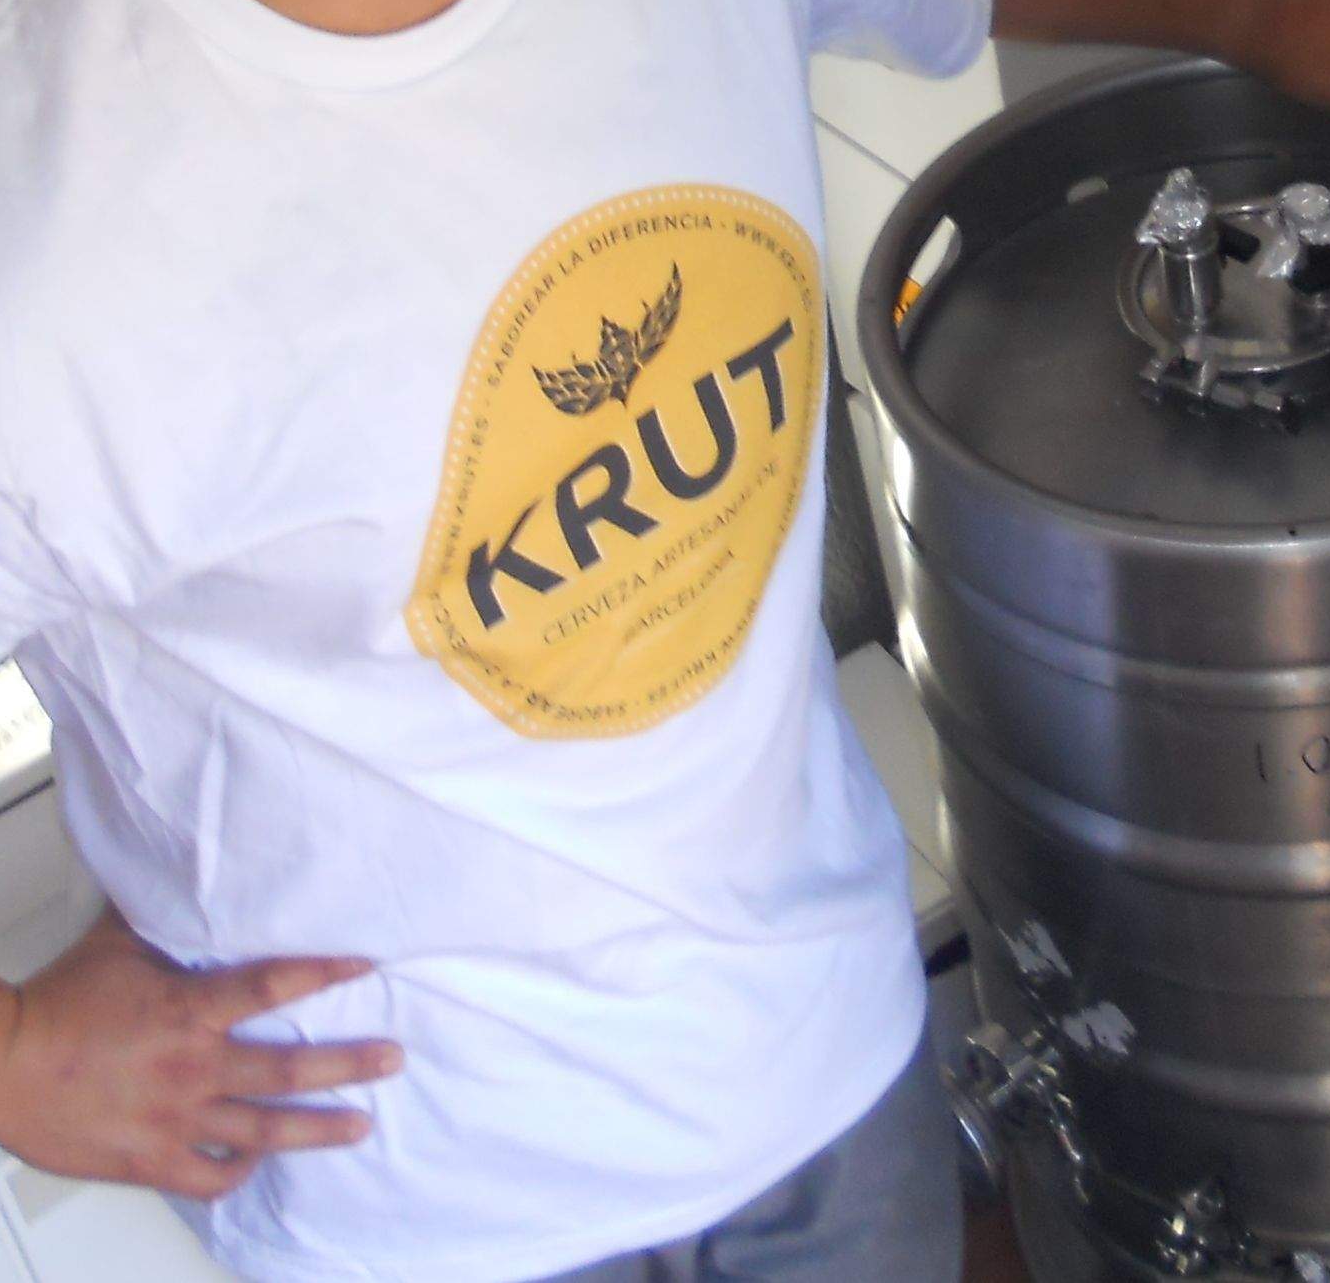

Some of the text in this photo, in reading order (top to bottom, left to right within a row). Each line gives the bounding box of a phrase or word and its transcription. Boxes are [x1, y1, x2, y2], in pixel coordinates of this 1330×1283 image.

[487, 272, 556, 388] SABOREAR
[557, 249, 584, 276] LA
[587, 214, 713, 256] DIFERENCIA
[465, 317, 795, 631] KRUT
[542, 572, 648, 646] CERVEZA
